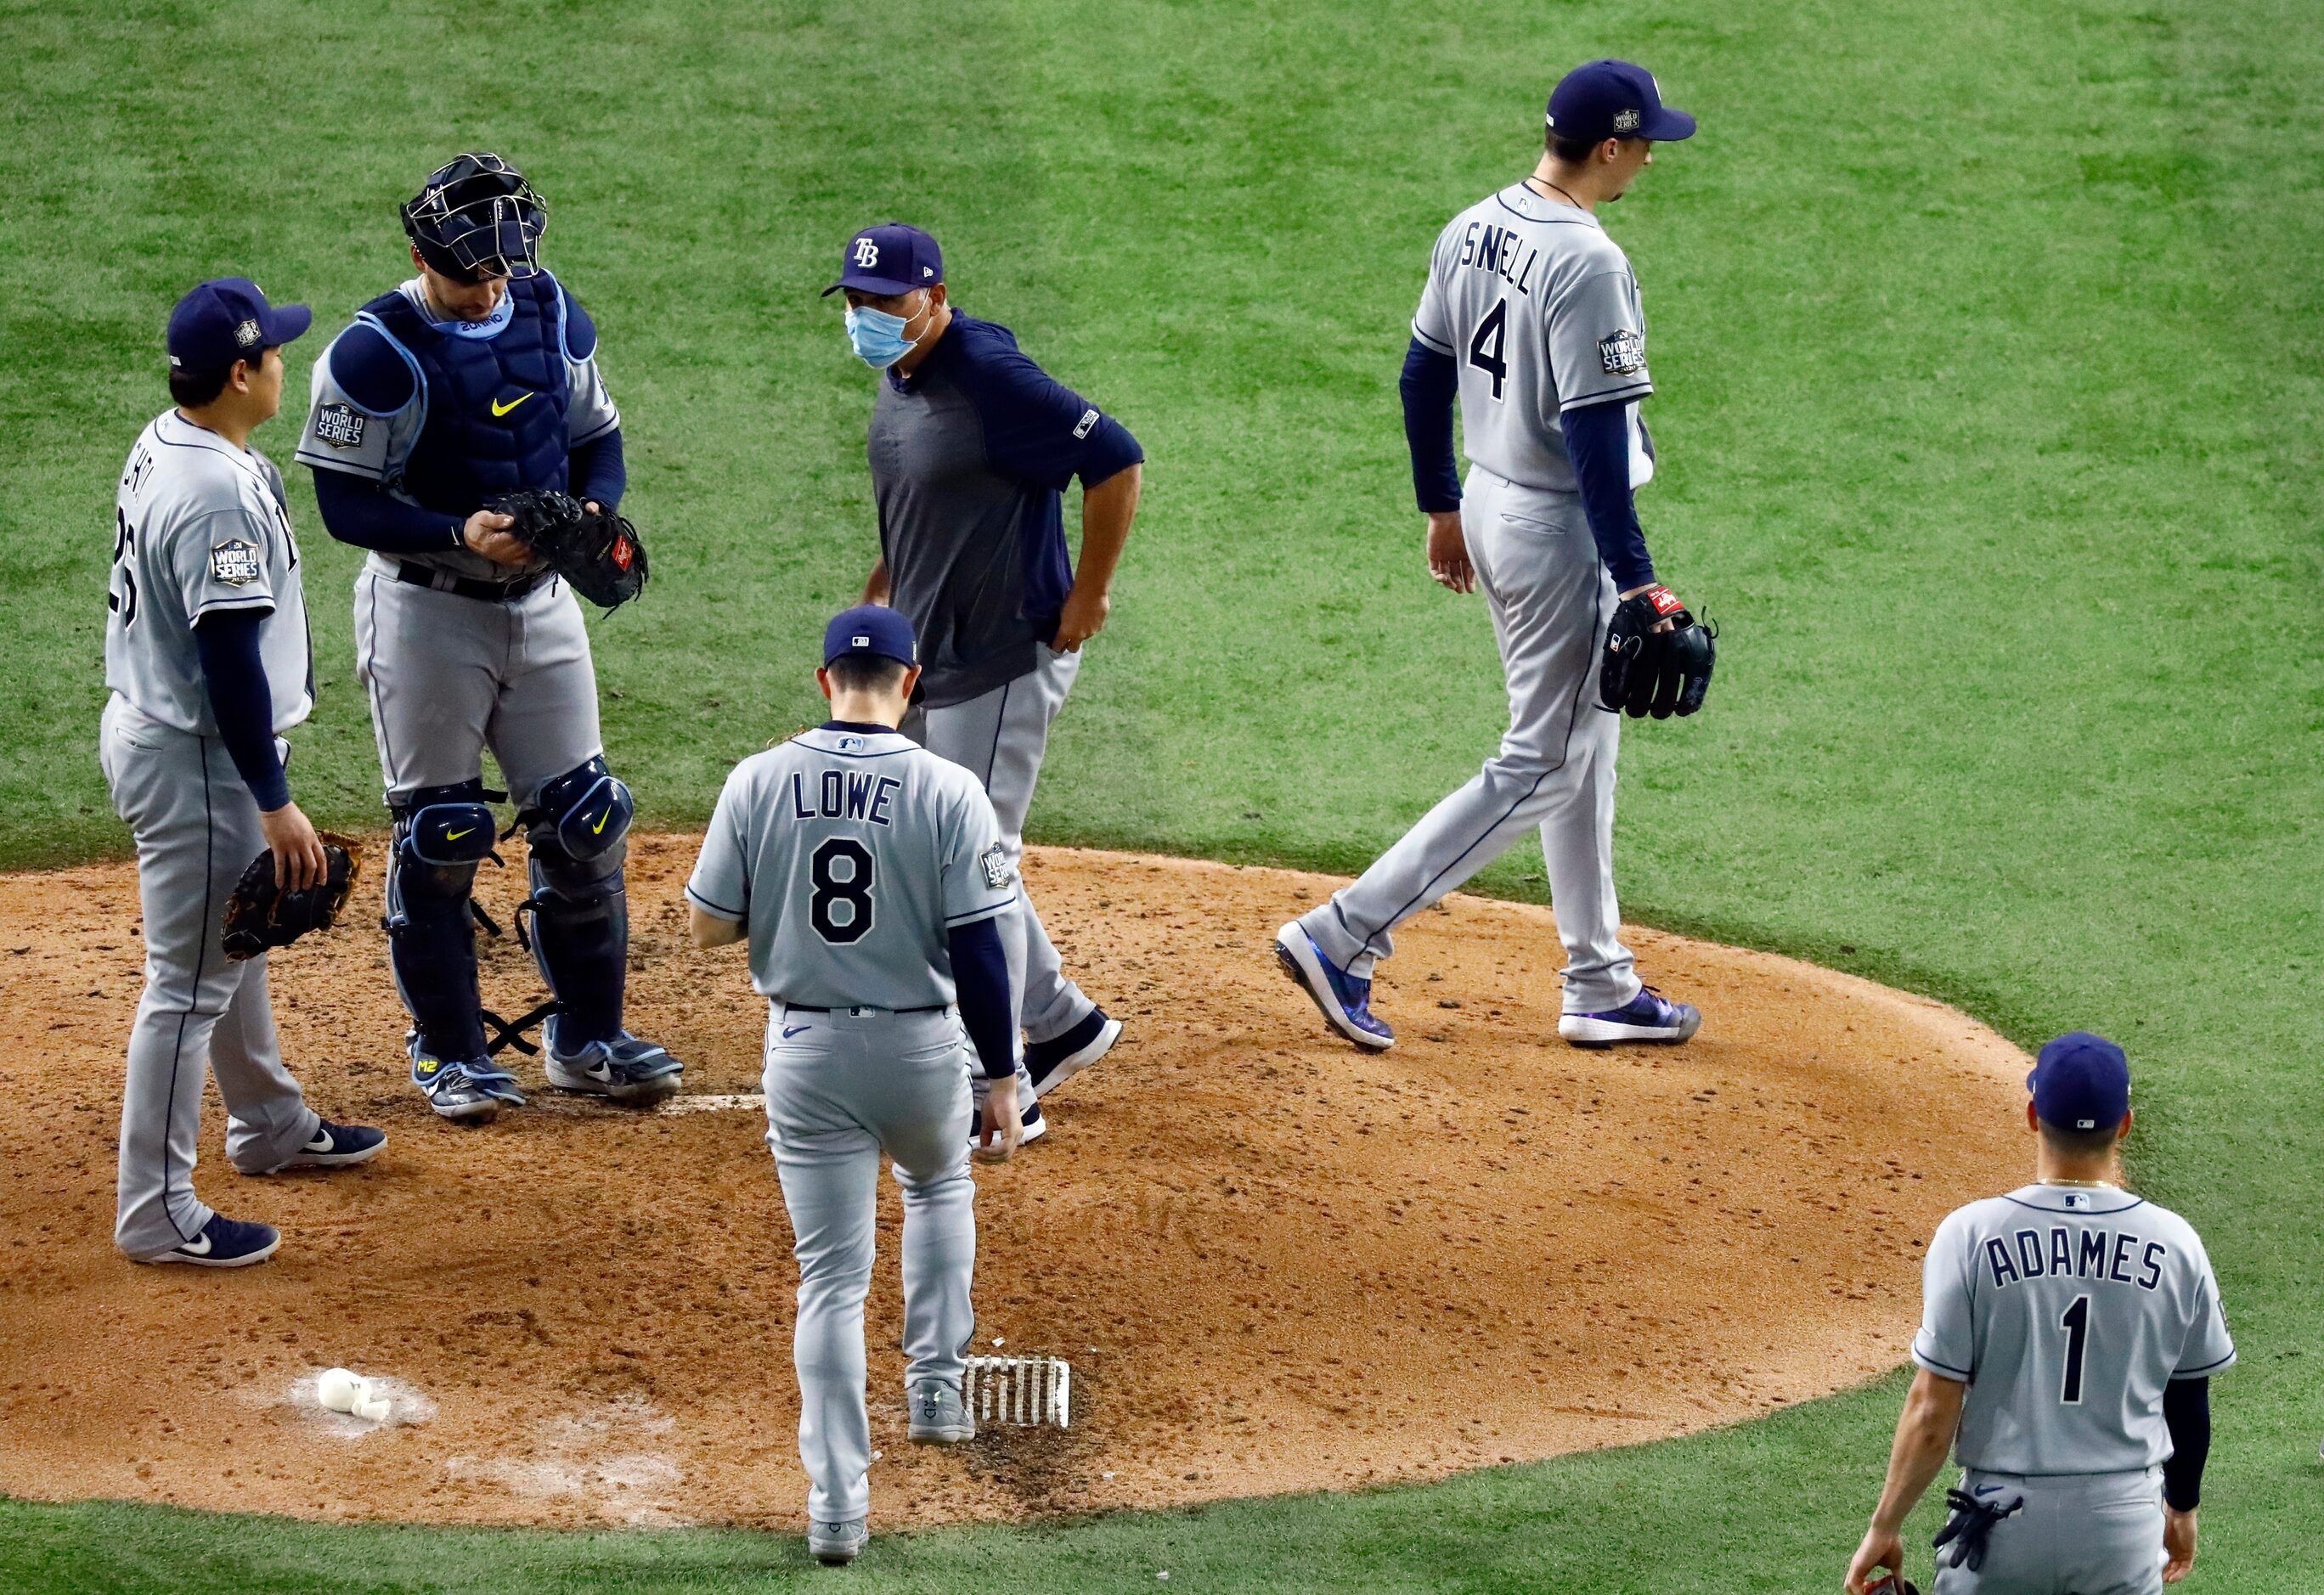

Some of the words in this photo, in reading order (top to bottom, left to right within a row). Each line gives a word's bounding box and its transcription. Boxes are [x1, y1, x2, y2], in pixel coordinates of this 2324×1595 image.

[1615, 113, 1638, 122] WORLD
[1616, 119, 1638, 129] SERIES
[854, 238, 879, 269] TB
[1461, 222, 1538, 296] SNELL
[1467, 294, 1509, 405] 4
[1600, 339, 1640, 357] WORLD
[1603, 351, 1645, 370] SERIES
[321, 409, 364, 431] WORLD
[317, 421, 361, 443] SERIES
[214, 550, 257, 564] WORLD
[215, 562, 257, 578] SERIES
[792, 769, 902, 828] LOWE
[808, 835, 877, 946] 8
[1985, 1226, 2167, 1292] ADAMES
[2059, 1293, 2092, 1406] 1
